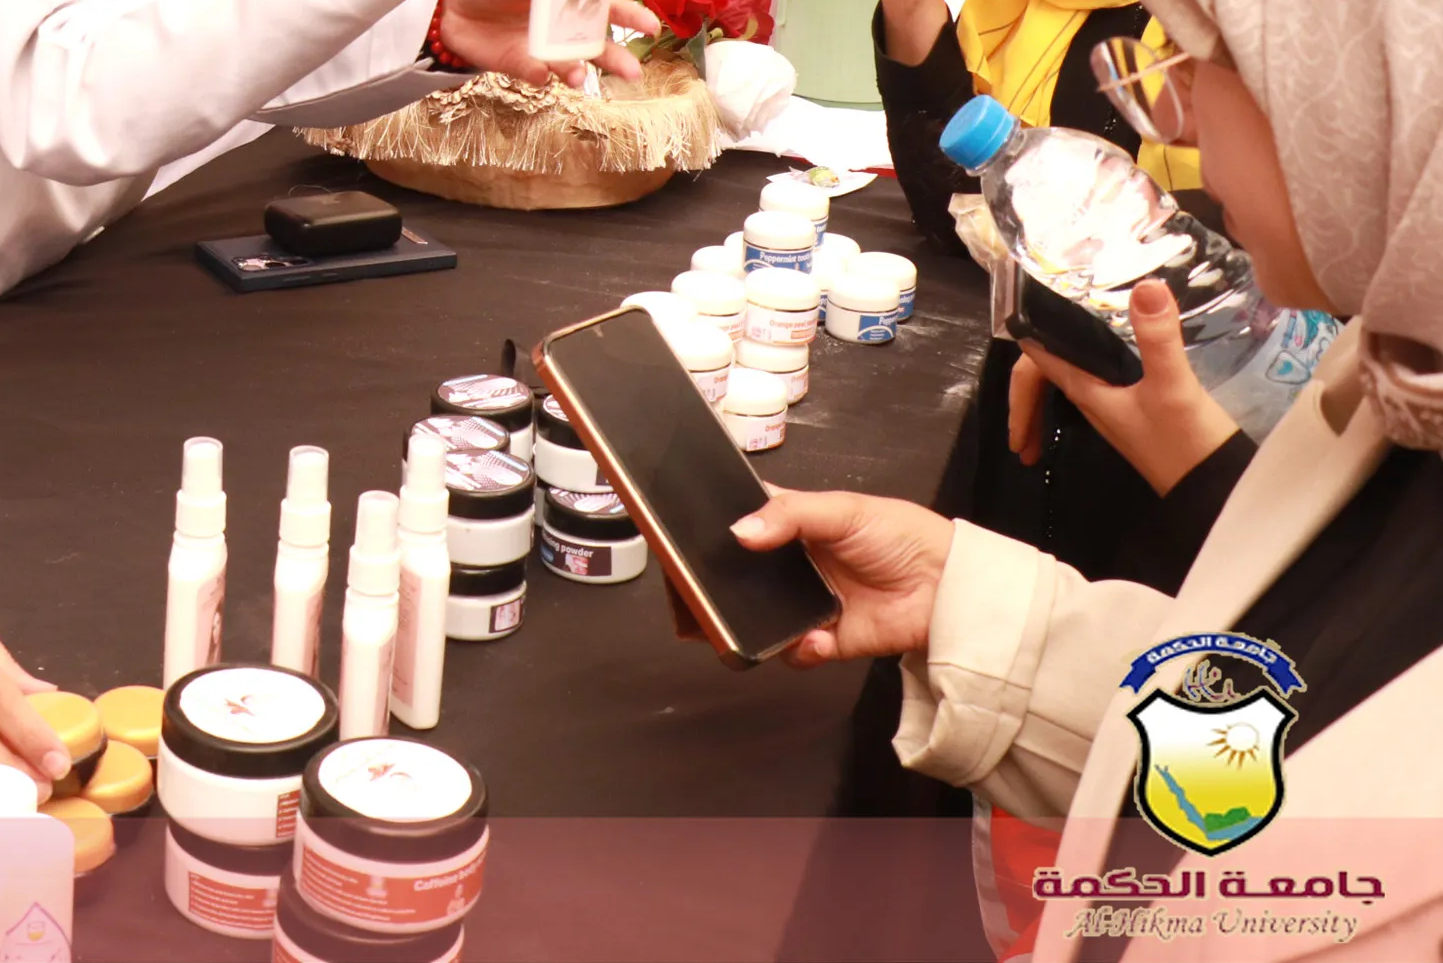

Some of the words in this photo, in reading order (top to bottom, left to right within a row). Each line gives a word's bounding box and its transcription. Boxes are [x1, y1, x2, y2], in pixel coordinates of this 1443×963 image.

[759, 251, 797, 264] Peppermint
[769, 319, 793, 329] Orange
[560, 544, 594, 558] powder
[413, 874, 458, 891] Caffeine
